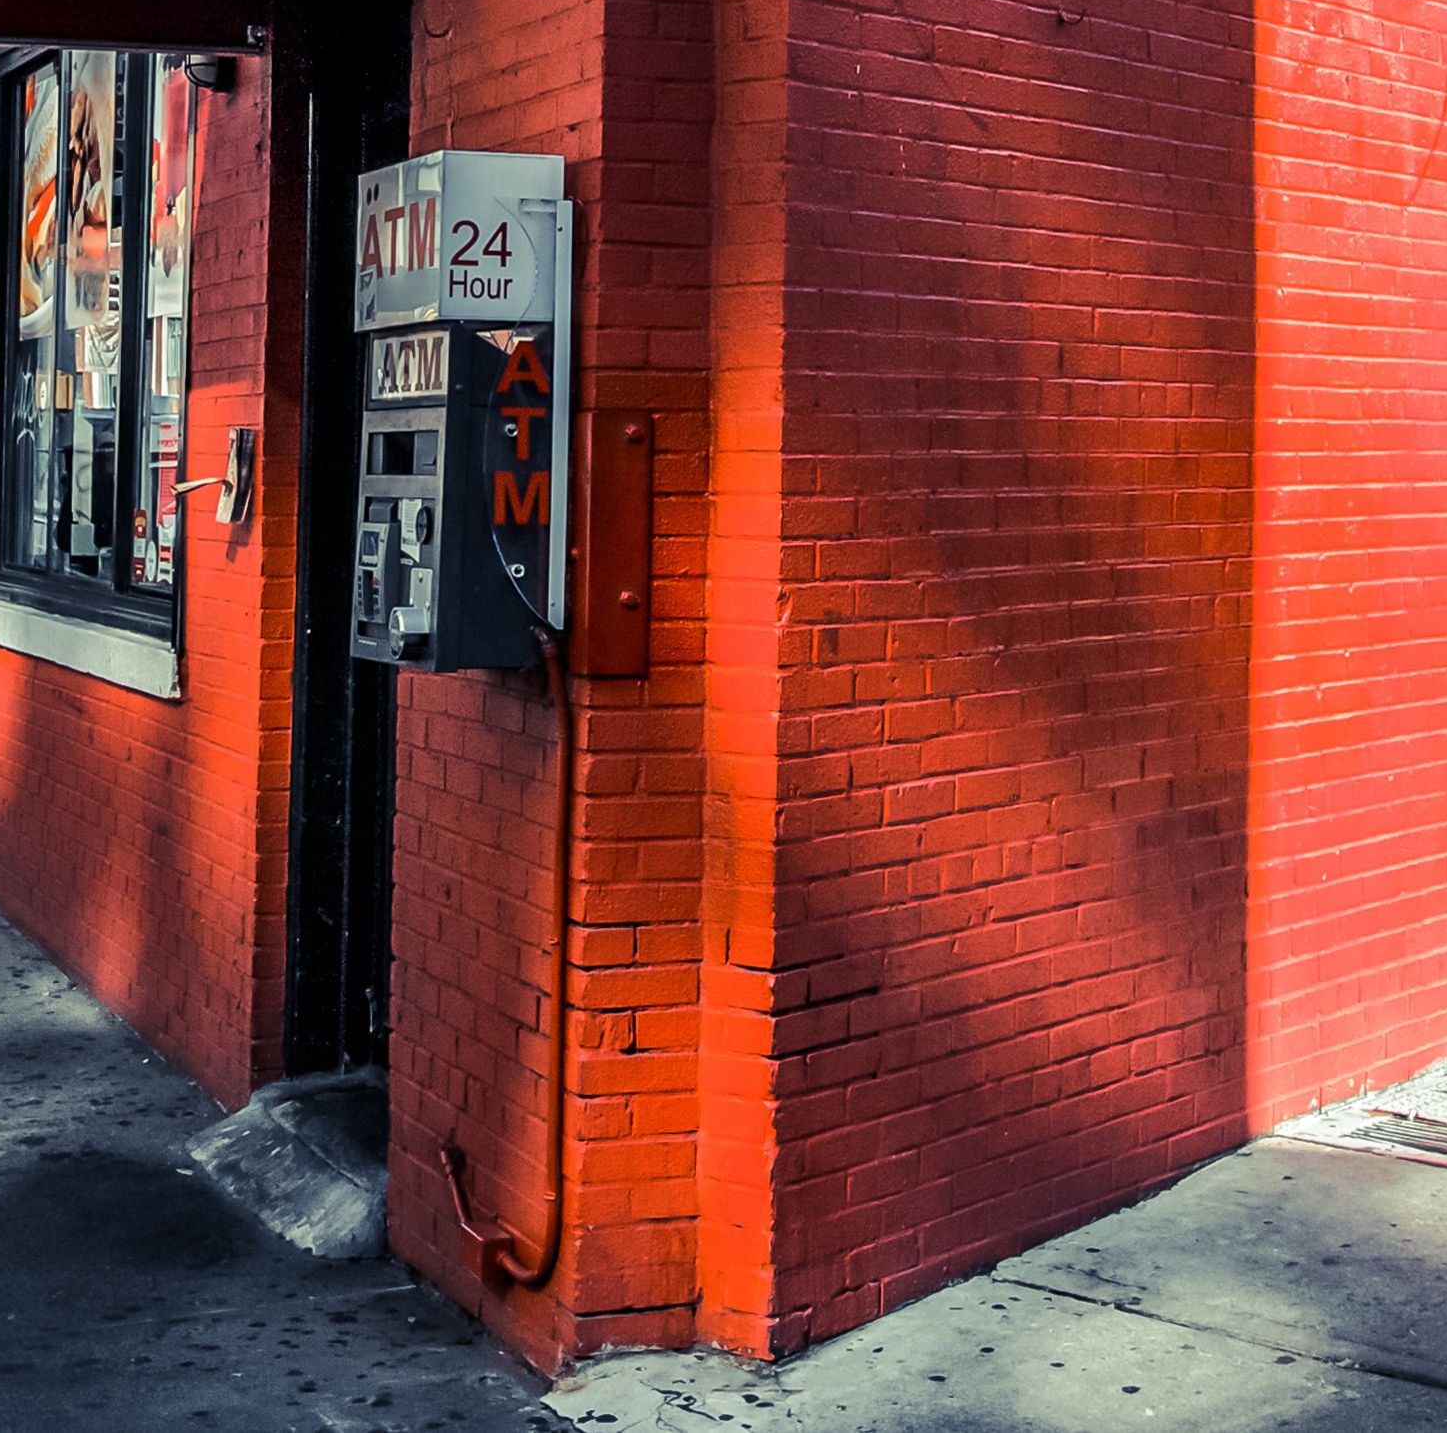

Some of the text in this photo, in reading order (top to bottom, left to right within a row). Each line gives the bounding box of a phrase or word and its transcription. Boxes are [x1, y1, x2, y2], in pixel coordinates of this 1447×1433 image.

[360, 197, 436, 280] ATM
[451, 220, 513, 267] 24
[448, 269, 513, 301] Hour
[378, 335, 444, 396] ATM
[492, 340, 551, 526] ATM
